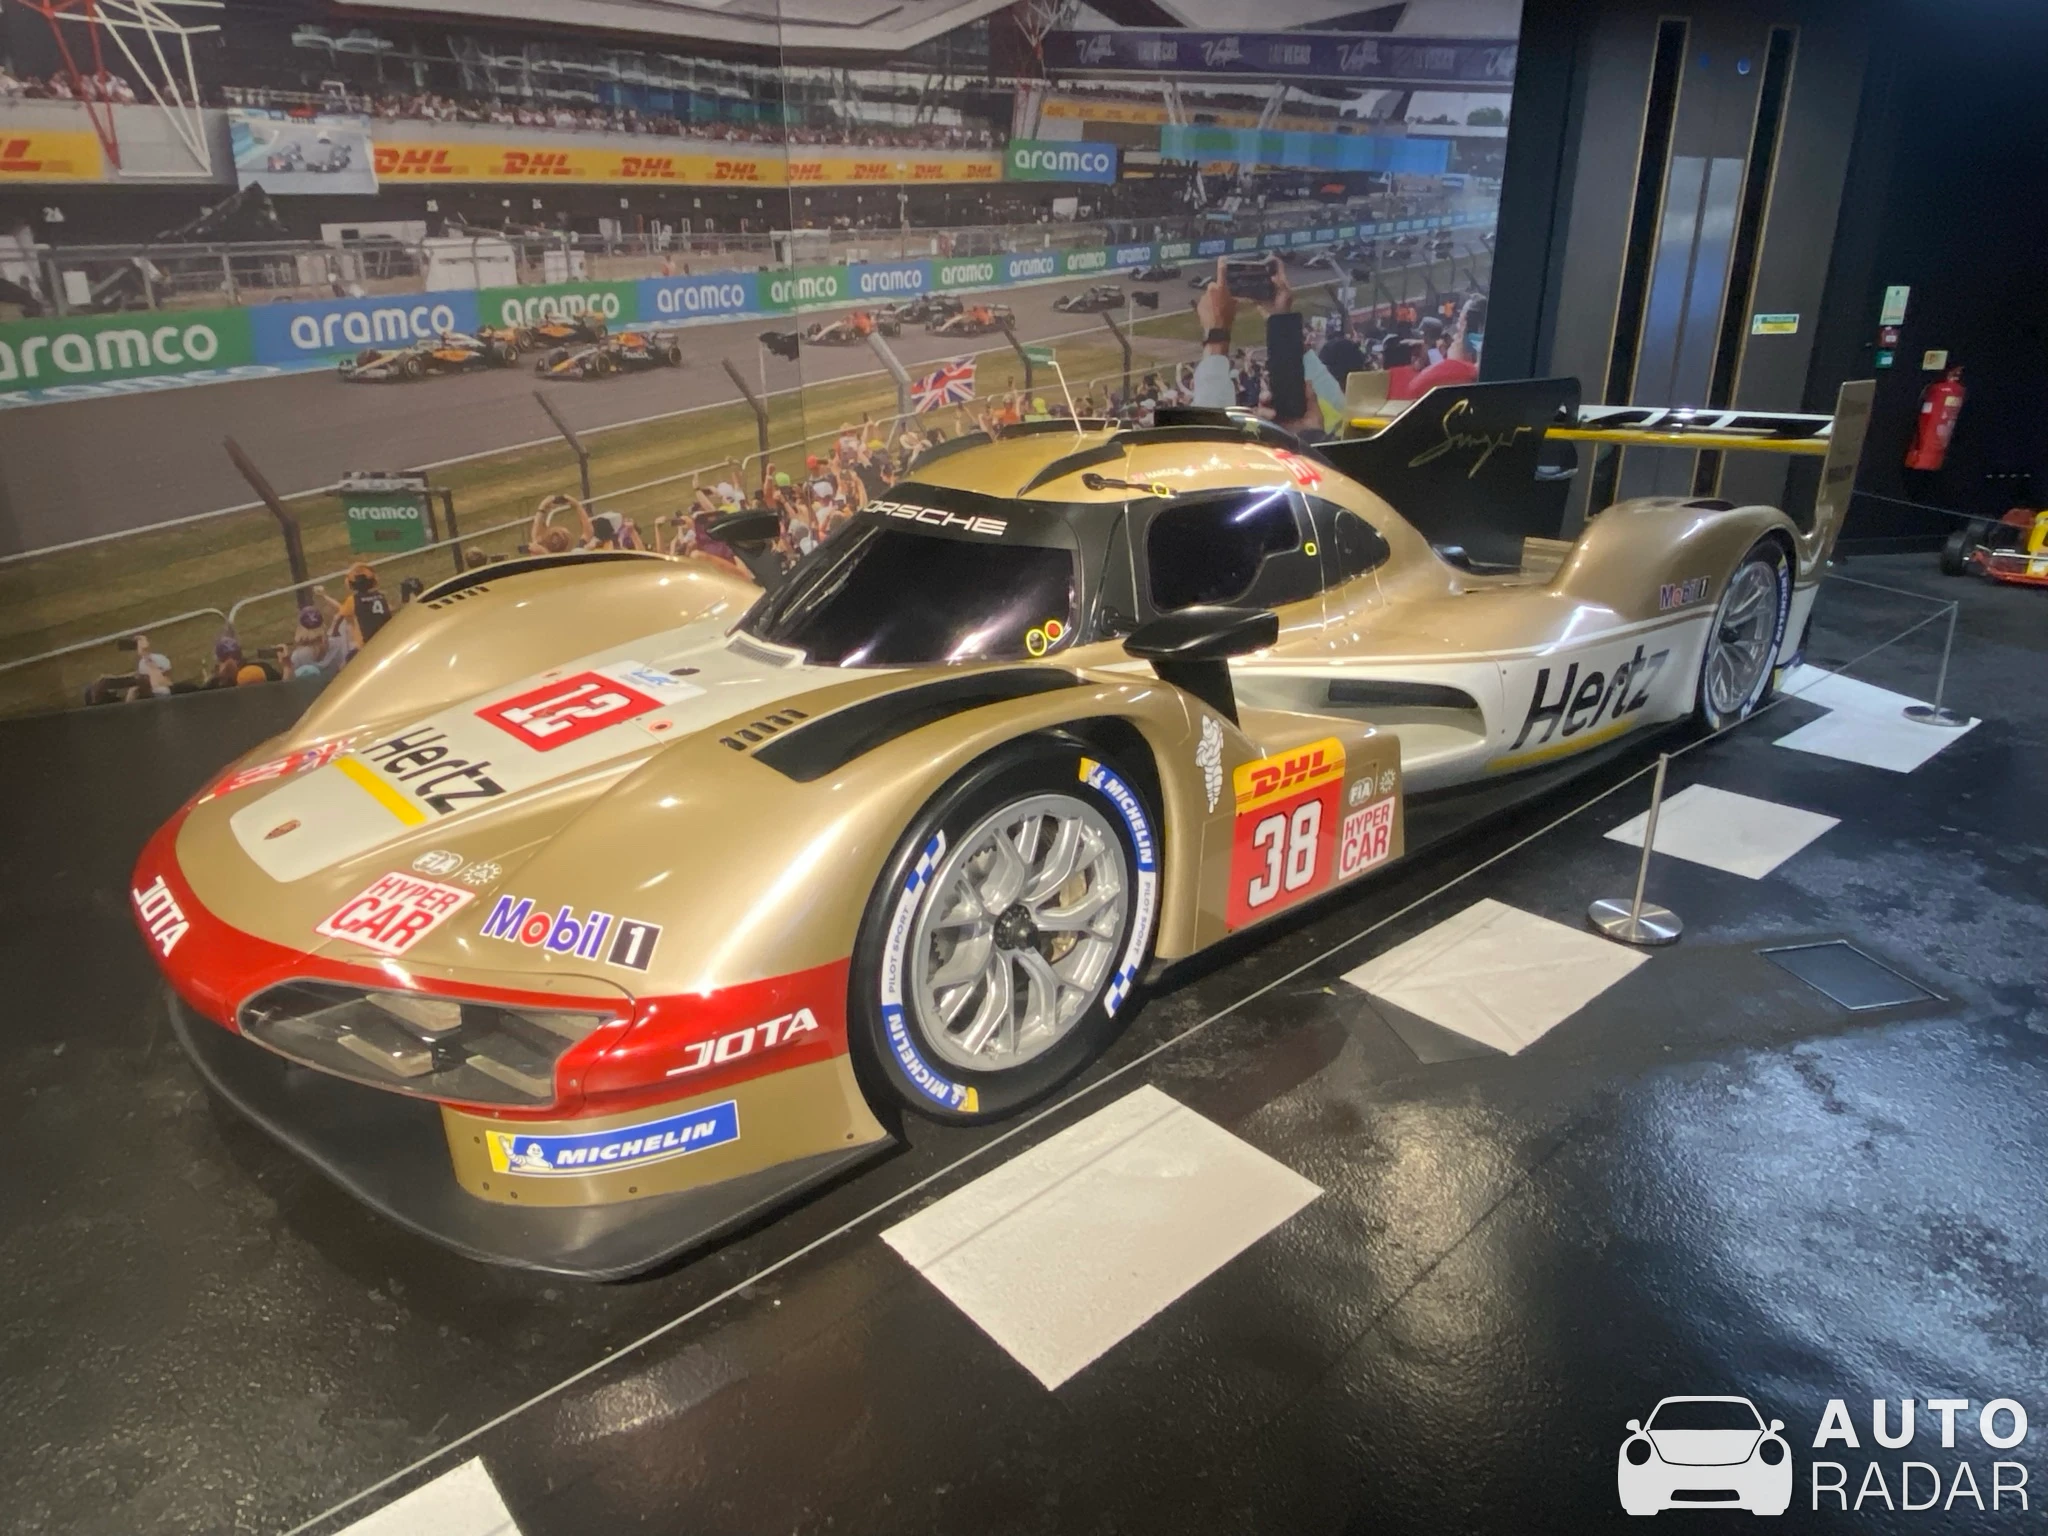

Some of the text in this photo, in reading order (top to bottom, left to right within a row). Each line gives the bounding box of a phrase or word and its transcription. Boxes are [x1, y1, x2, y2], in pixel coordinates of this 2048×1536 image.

[374, 149, 452, 174] DHL
[503, 152, 571, 176] DHL
[621, 157, 676, 178] DHL
[715, 162, 759, 181] DHL
[789, 163, 823, 180] DHL
[854, 164, 888, 180] DHL
[914, 165, 943, 179] DHL
[967, 165, 992, 178] DHL
[1015, 150, 1109, 172] aramco
[1010, 257, 1053, 277] aramco
[1067, 251, 1106, 271] aramco
[1117, 247, 1150, 265] aramco
[861, 269, 922, 292] aramco
[941, 263, 993, 284] aramco
[657, 284, 744, 313] aramco
[771, 276, 837, 303] aramco
[291, 305, 455, 349] aramco
[349, 506, 418, 520] aramco
[863, 499, 1007, 536] ORSCHE
[372, 600, 384, 614] 4
[1509, 644, 1670, 751] Hertz
[361, 727, 507, 815] Hertz
[1251, 750, 1332, 798] DHL
[1350, 781, 1370, 801] FIA
[1105, 779, 1153, 864] MICHELIN
[1345, 804, 1390, 840] HYPER
[1248, 798, 1324, 909] 38
[1342, 825, 1388, 872] CAR
[418, 853, 455, 873] FIA
[368, 876, 462, 914] HYPER
[133, 875, 190, 957] JOTA
[330, 897, 435, 949] CAR
[480, 894, 614, 961] Mobil
[888, 904, 910, 993] PILOT SPORT
[666, 1008, 819, 1077] JOTA
[888, 1012, 949, 1100] MICHELIN
[557, 1120, 716, 1165] MICHELIN
